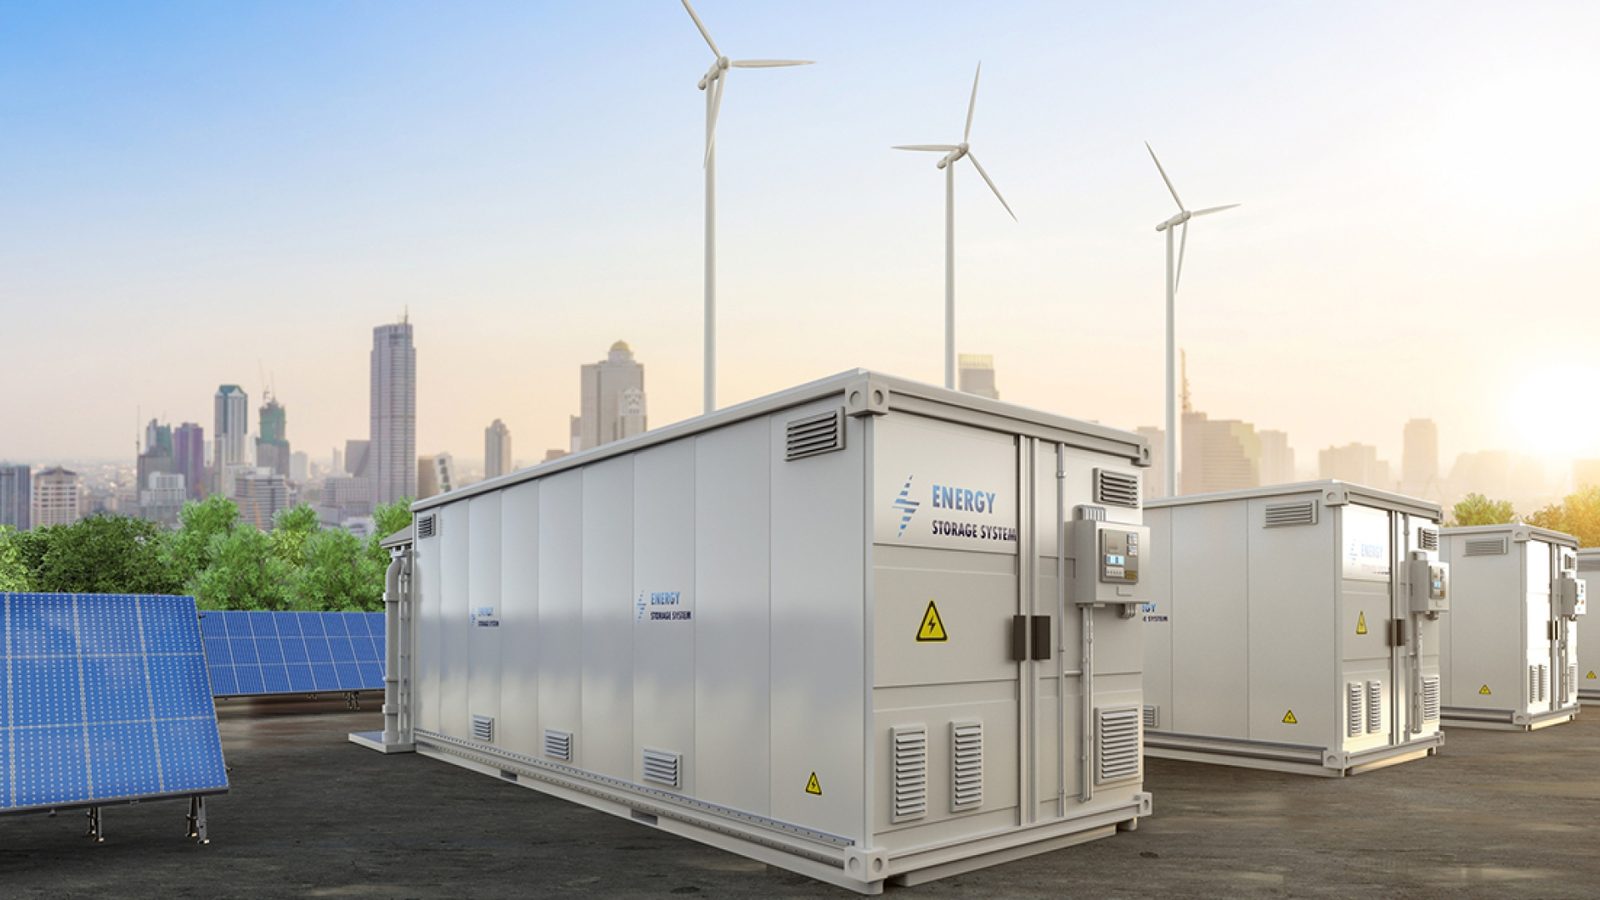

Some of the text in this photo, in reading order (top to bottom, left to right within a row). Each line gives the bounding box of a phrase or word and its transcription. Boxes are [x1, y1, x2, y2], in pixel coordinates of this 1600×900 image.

[932, 484, 996, 514] ENERGY
[932, 519, 1017, 541] STORAGE SYSTEM
[651, 591, 680, 605] ENERGY
